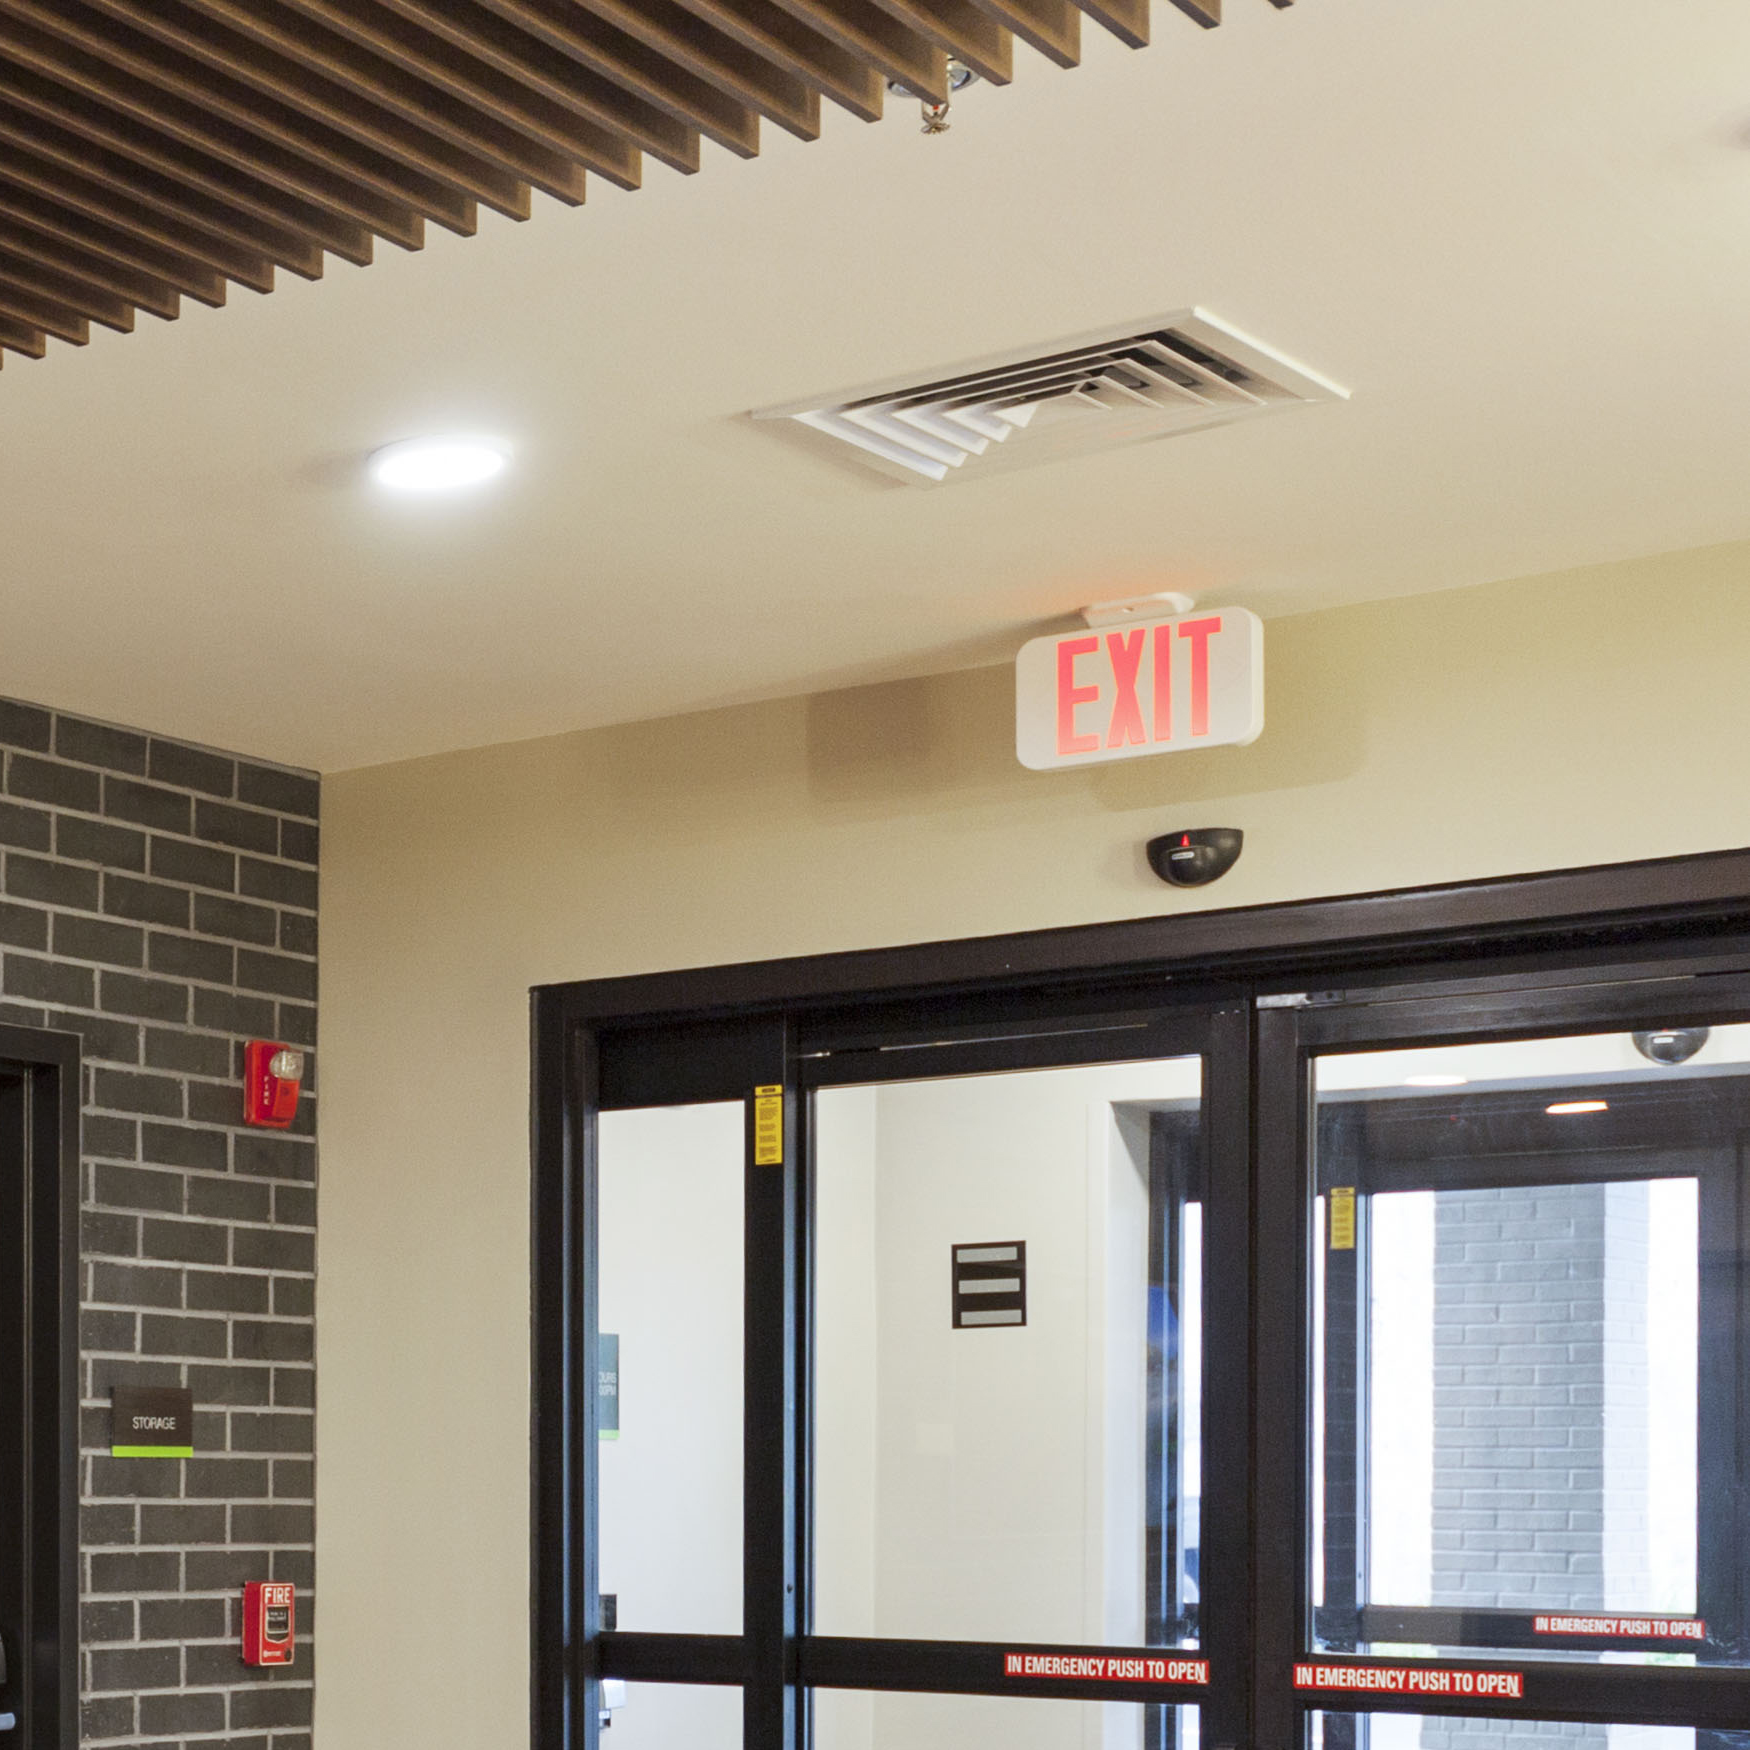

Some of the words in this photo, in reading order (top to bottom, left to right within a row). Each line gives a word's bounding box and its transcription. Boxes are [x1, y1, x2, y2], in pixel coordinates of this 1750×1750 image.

[1057, 616, 1221, 756] EXIT
[132, 1416, 176, 1430] STORAGE
[264, 1587, 291, 1604] FIRE
[1534, 1616, 1549, 1631] IN
[1550, 1618, 1618, 1633] EMERGENCY
[1620, 1620, 1650, 1634] PUSH
[1652, 1621, 1668, 1636] TO
[1670, 1622, 1703, 1638] OPEN
[1008, 1655, 1022, 1673] IN
[1025, 1656, 1106, 1677] EMERGENCY
[1108, 1658, 1144, 1678] PUSH
[1147, 1660, 1165, 1679] TO
[1168, 1662, 1207, 1682] OPEN
[1296, 1666, 1313, 1686] IN
[1316, 1667, 1406, 1689] EMERGENCY
[1409, 1671, 1450, 1691] PUSH
[1452, 1672, 1474, 1692] TO
[1476, 1674, 1520, 1697] OPEN
